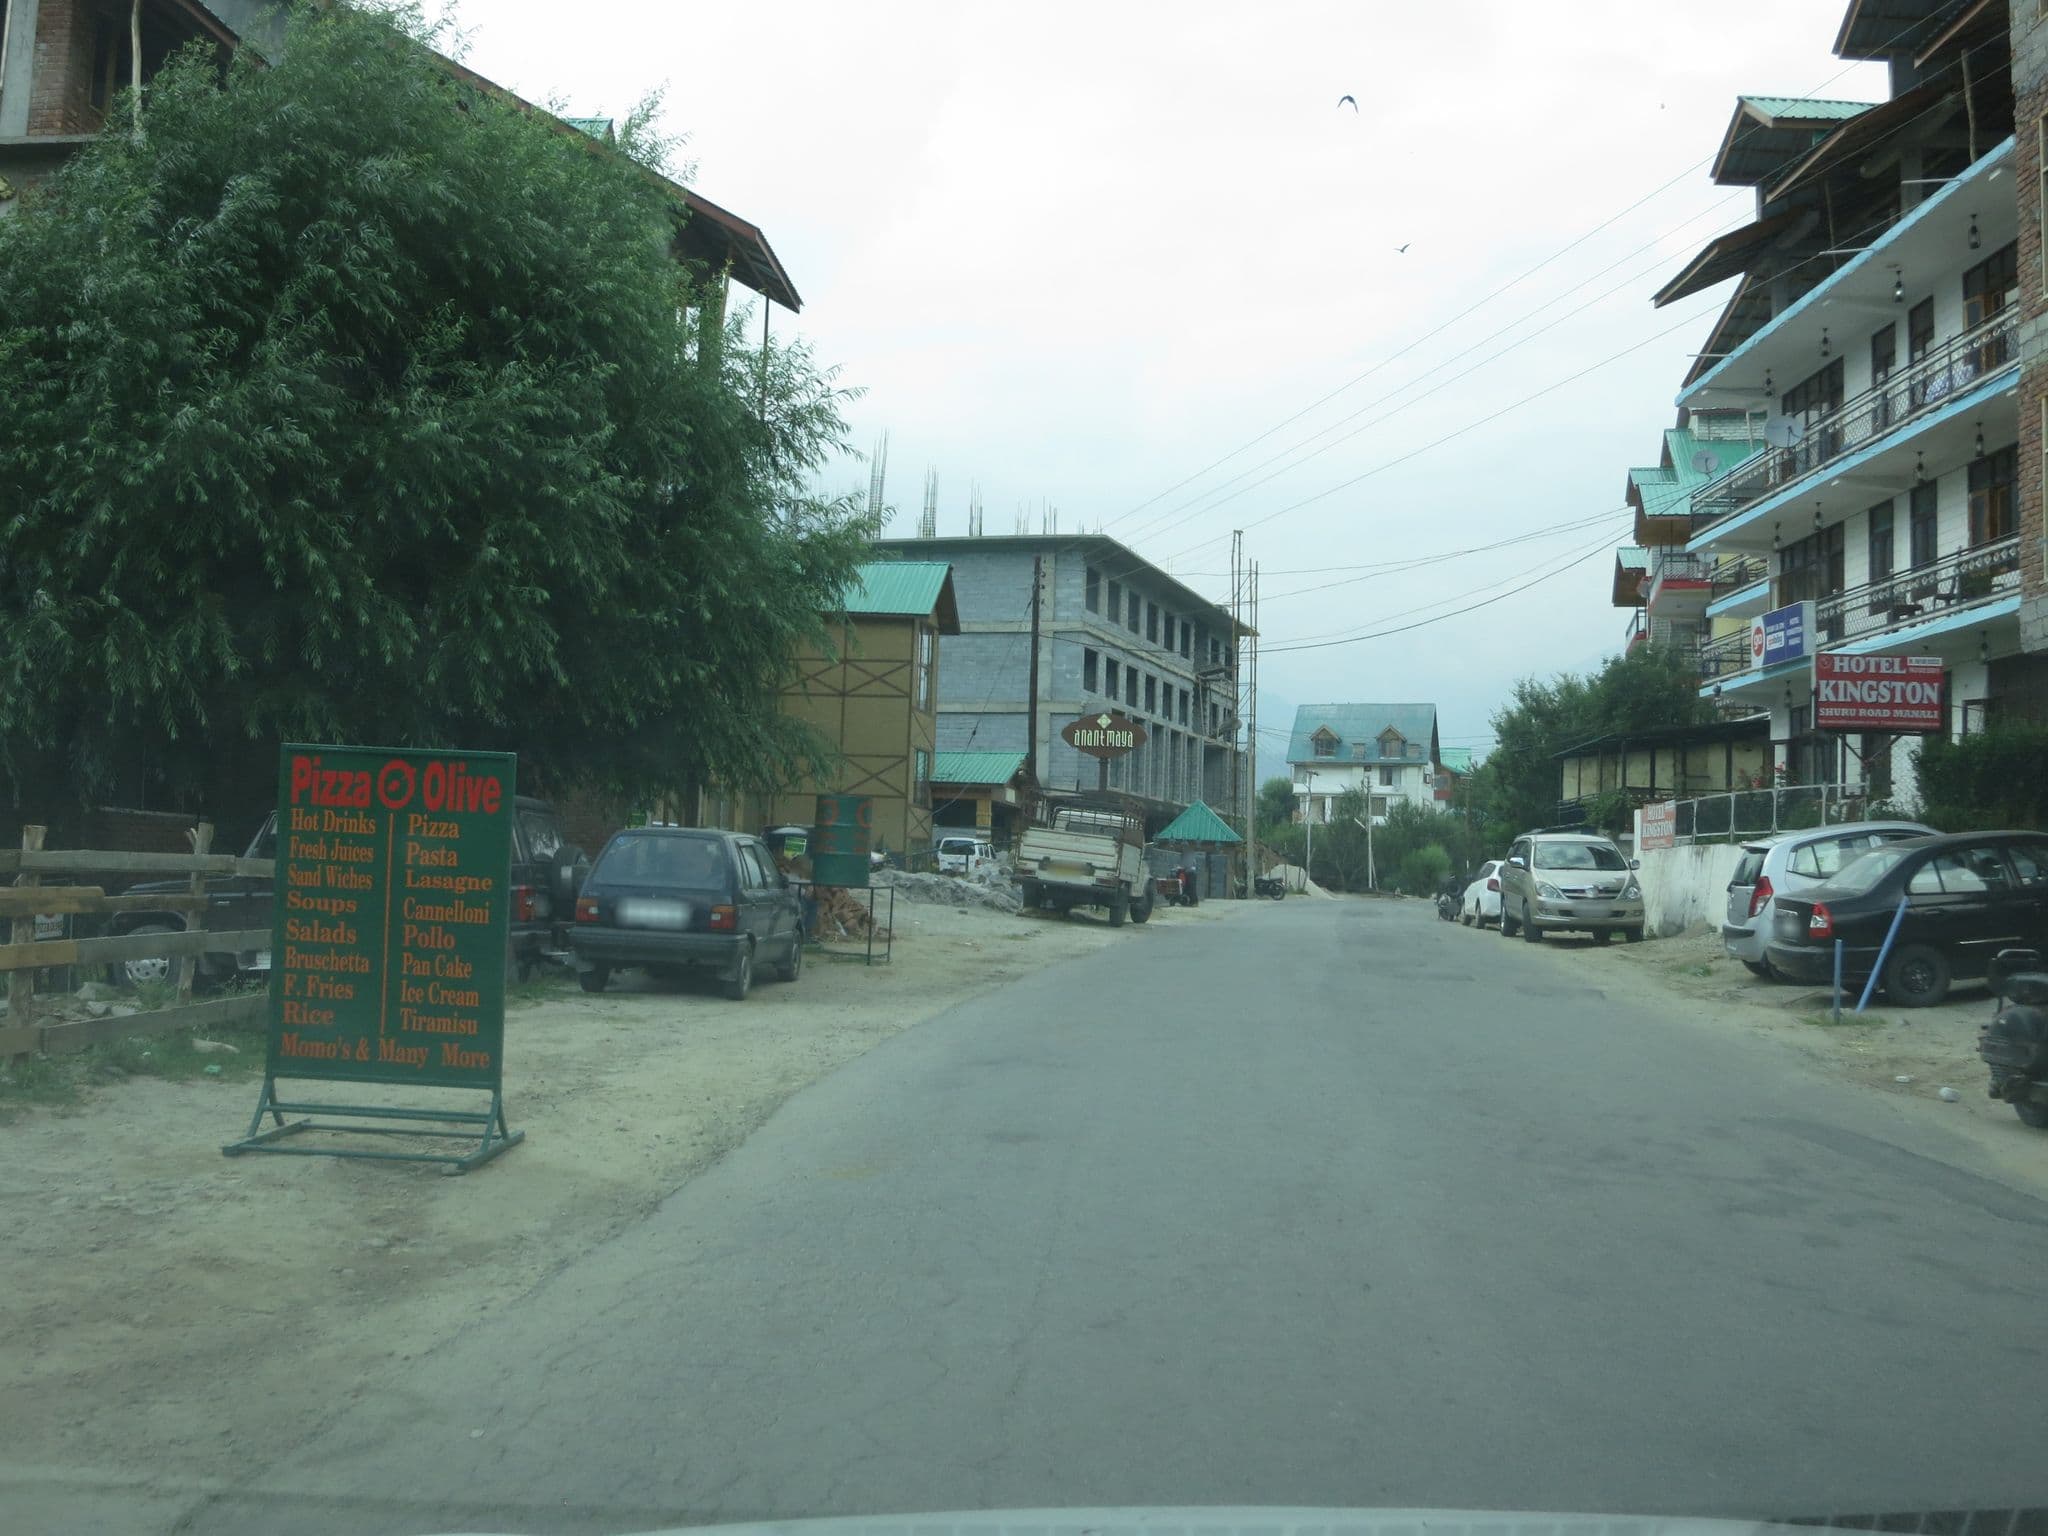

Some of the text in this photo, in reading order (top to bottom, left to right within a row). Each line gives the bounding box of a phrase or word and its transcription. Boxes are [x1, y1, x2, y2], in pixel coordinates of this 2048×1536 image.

[1833, 656, 1907, 674] HOTEL
[1818, 680, 1940, 705] KINGSTON
[1819, 707, 1939, 719] SHURU ROAD MANALI
[292, 757, 501, 813] Pizza Olive
[292, 809, 376, 833] Hot Drinks
[408, 814, 460, 837] Pizza
[290, 837, 374, 862] Fresh Juices
[406, 842, 458, 866] Pasta
[289, 864, 372, 889] Sand Wiches
[406, 870, 493, 893] Lasagne
[288, 891, 356, 915] Soups
[404, 897, 489, 923] Cannelloni
[287, 919, 356, 943] Salads
[404, 925, 455, 948] Pollo
[285, 946, 369, 972] Bruschetta
[403, 953, 471, 977] Pan Cake
[284, 975, 353, 998] F. Fries
[402, 980, 479, 1005] Ice Cream
[283, 1001, 334, 1024] Rice
[402, 1008, 477, 1034] Tiramisu
[356, 1038, 369, 1060] &
[379, 1039, 428, 1067] Many
[442, 1044, 490, 1067] More
